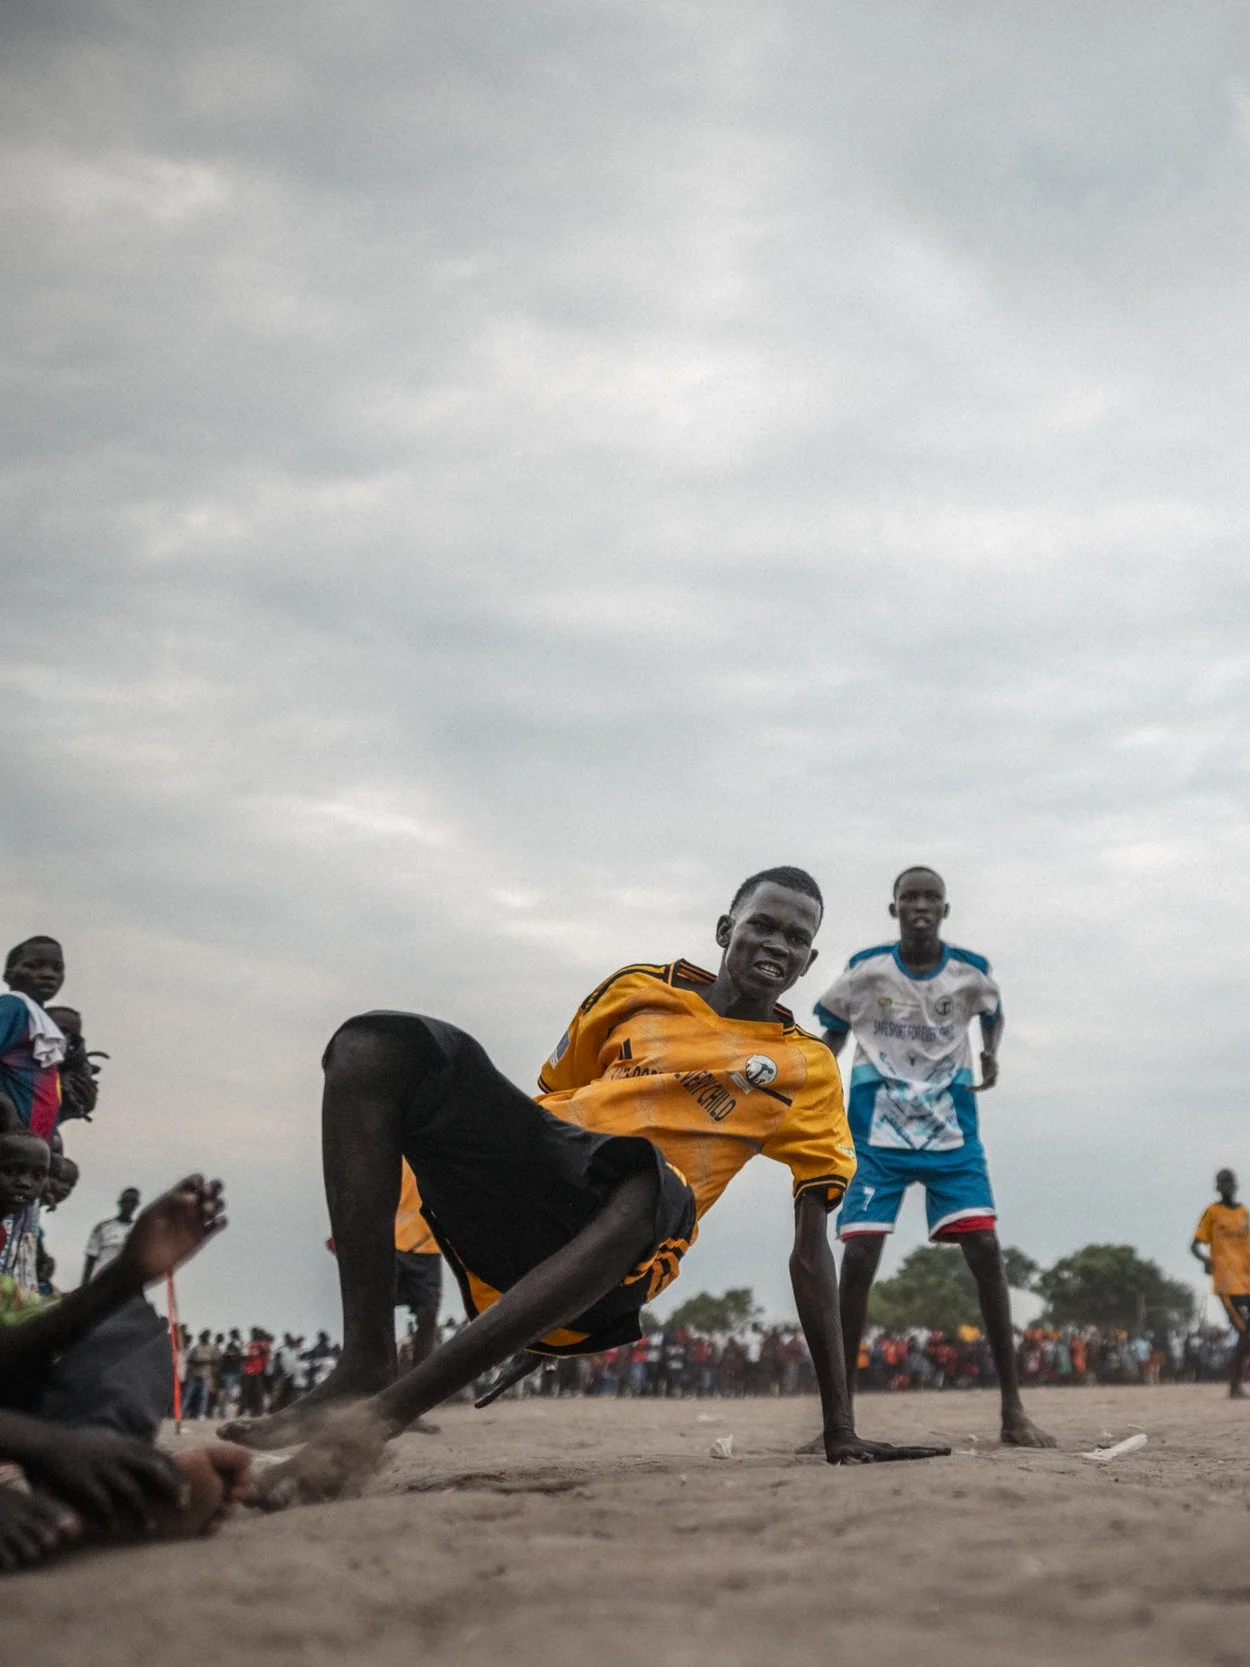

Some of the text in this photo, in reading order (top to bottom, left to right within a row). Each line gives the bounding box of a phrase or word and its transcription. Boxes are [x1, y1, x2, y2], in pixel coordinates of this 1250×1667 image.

[873, 1020, 889, 1037] SAFE
[889, 1021, 907, 1038] SPORT
[908, 1024, 921, 1040] FOR
[674, 1070, 718, 1096] VERY
[697, 1084, 737, 1122] CHILD
[863, 1186, 876, 1211] 7
